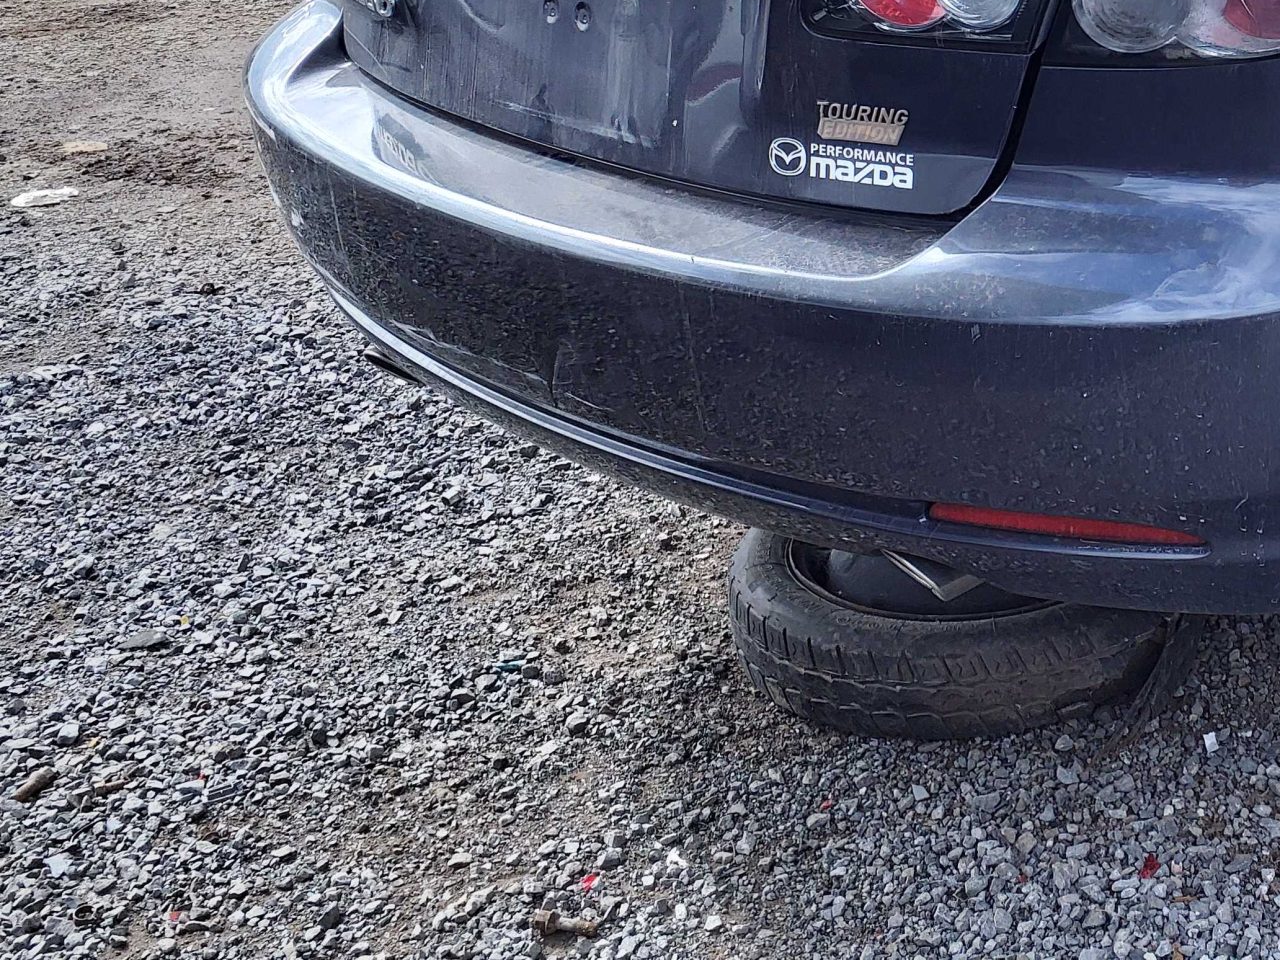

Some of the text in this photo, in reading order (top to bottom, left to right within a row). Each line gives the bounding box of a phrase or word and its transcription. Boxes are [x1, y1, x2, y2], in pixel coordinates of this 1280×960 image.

[816, 100, 909, 125] TOURING
[819, 119, 904, 145] EDITION
[810, 143, 914, 166] PERFORMANCE
